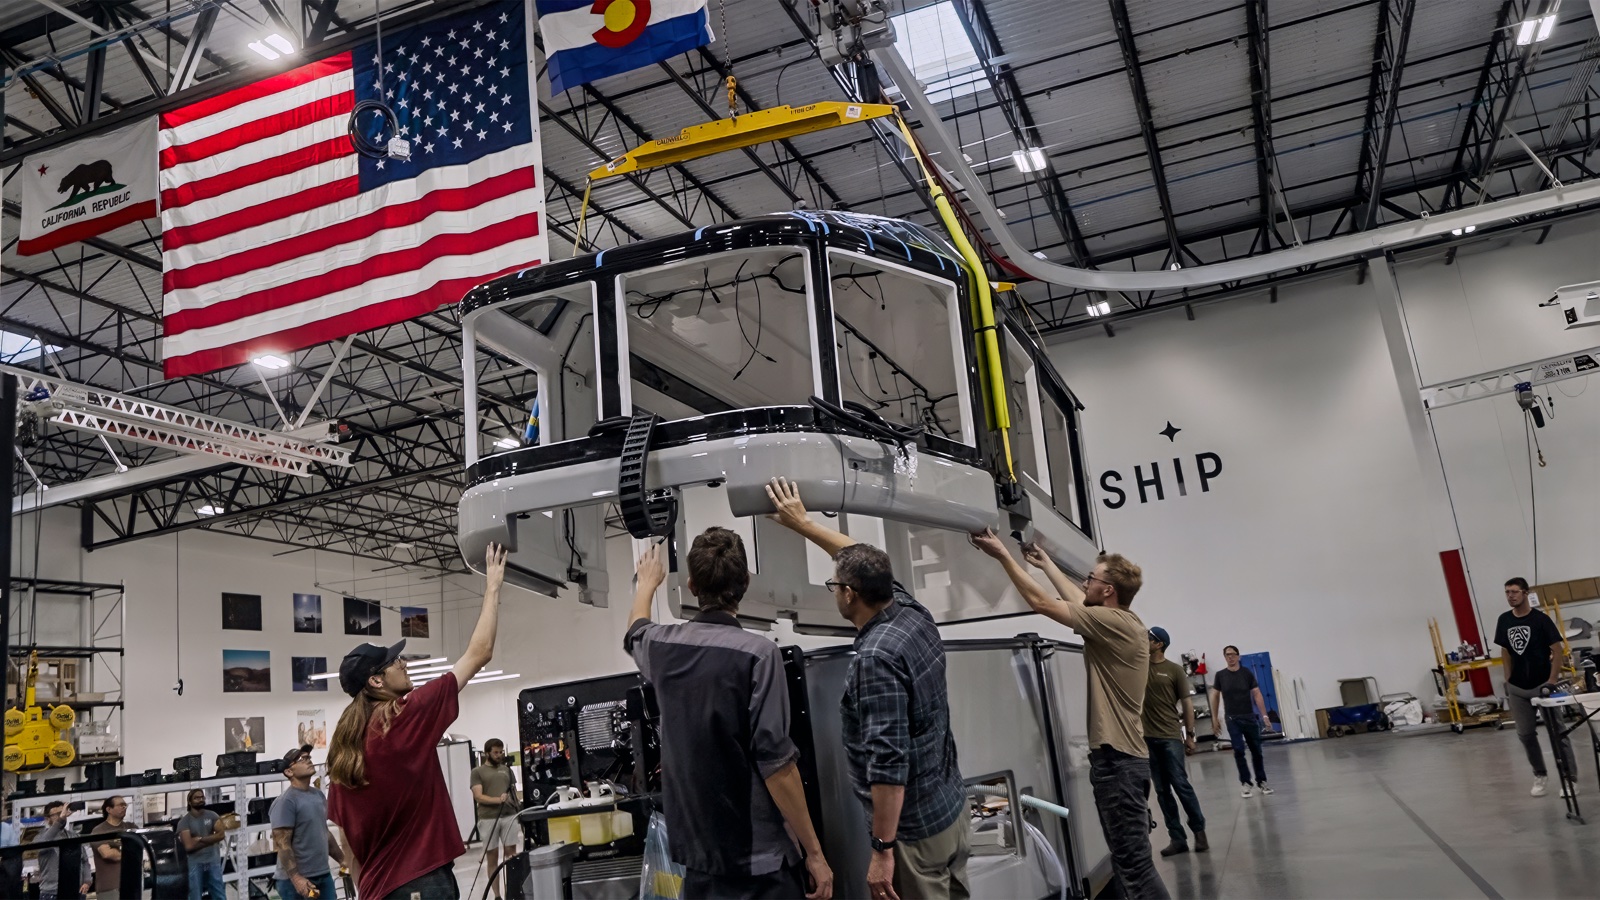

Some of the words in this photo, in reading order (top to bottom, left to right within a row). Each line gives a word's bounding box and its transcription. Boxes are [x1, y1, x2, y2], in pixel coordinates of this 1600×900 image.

[41, 205, 87, 229] CALIFORNIA
[92, 191, 131, 213] REPUBLIC
[1100, 452, 1222, 509] SHIP
[1514, 640, 1524, 649] 12
